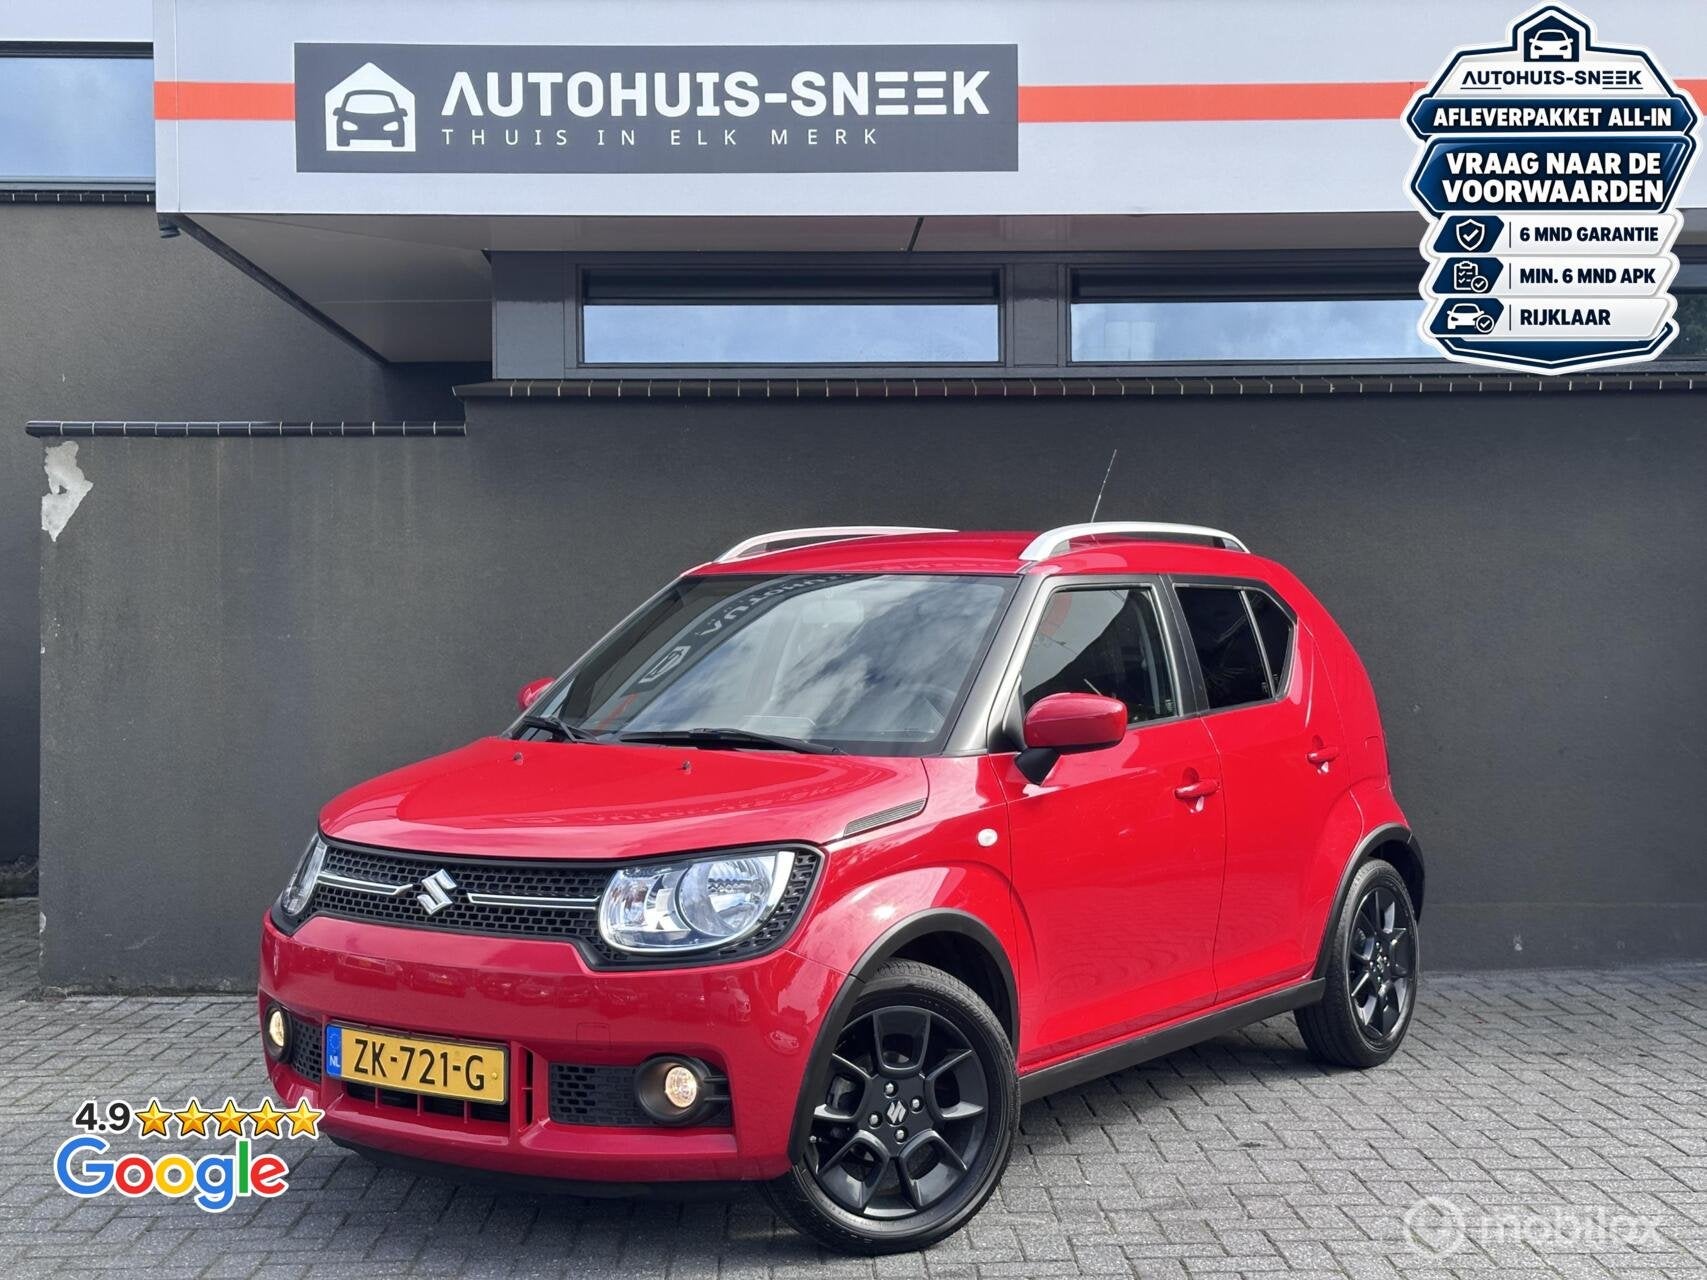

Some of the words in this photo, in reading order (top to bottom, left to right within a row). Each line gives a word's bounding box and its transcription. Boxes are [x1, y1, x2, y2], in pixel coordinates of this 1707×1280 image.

[441, 70, 991, 118] AUTOHUIS-SNEEK
[441, 128, 567, 146] THUIS
[597, 128, 636, 146] IN
[670, 128, 738, 146] ELK
[771, 128, 878, 146] MERK
[329, 1055, 341, 1068] NL
[353, 1038, 485, 1091] ZK-721-G
